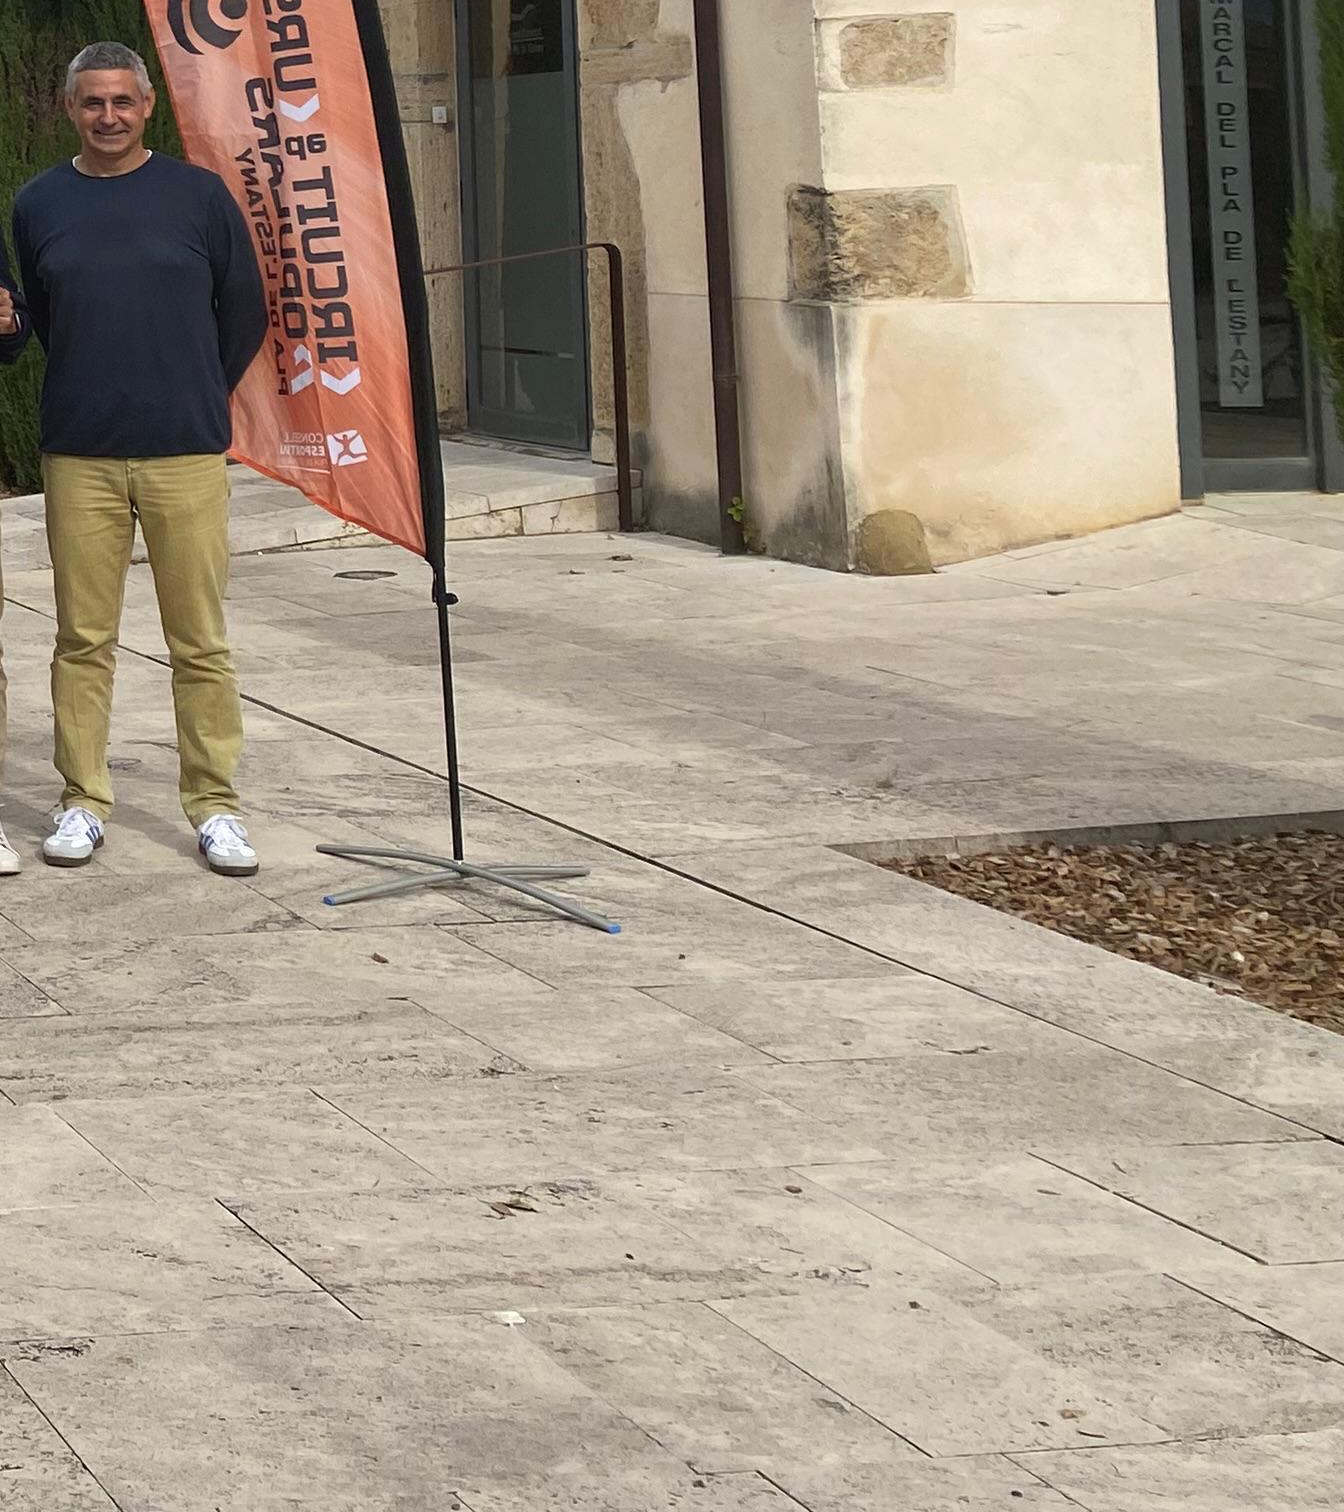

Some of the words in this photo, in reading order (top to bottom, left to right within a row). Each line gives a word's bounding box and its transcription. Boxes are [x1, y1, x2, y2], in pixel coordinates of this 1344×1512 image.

[1216, 102, 1237, 148] DEL
[1221, 166, 1241, 212] PLA
[1223, 231, 1243, 261] DE
